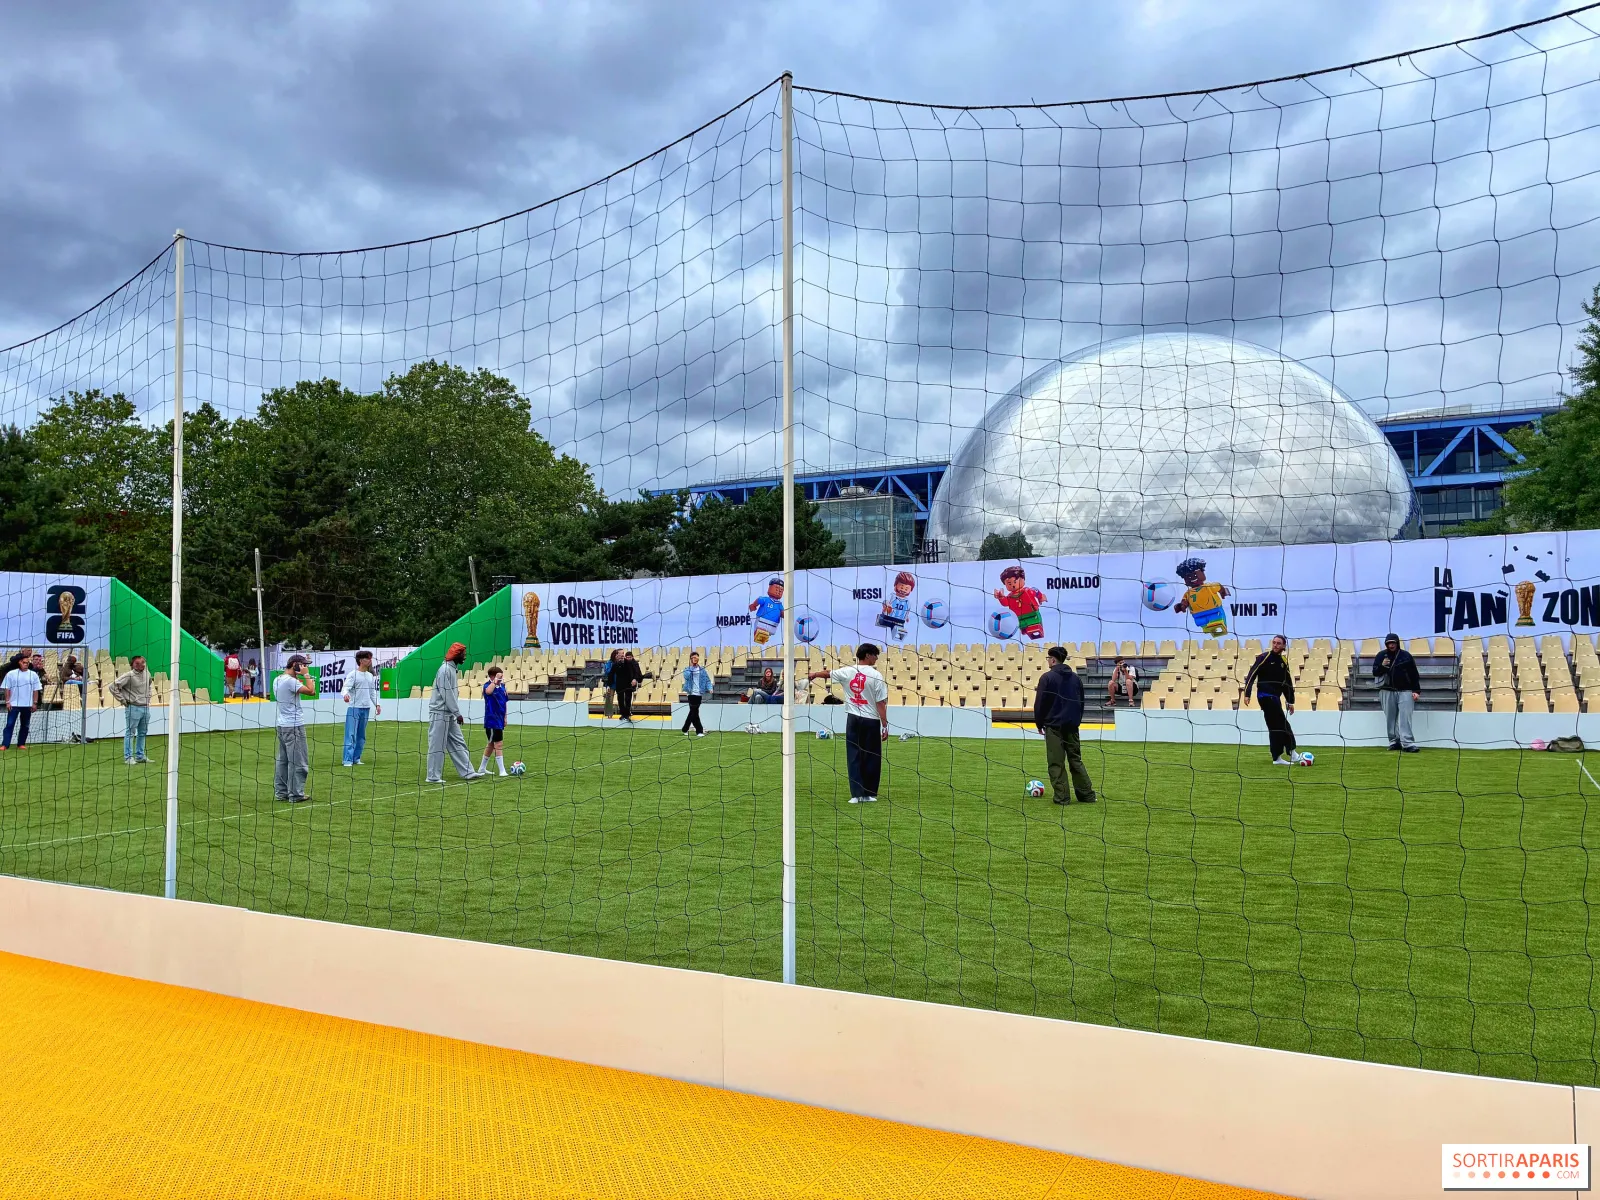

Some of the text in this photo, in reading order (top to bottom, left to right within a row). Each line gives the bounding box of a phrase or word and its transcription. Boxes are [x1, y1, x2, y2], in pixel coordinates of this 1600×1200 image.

[1046, 576, 1100, 590] RONALDO
[1434, 567, 1454, 588] LA
[852, 588, 882, 600] MESSI
[557, 594, 634, 623] CONSTRUISEZ
[1230, 603, 1278, 616] VINI JR
[1434, 584, 1600, 633] FAN ZON
[716, 612, 751, 627] MBAPPÉ
[56, 631, 75, 639] FIFA
[550, 620, 639, 645] VOTRE LÉGENDE
